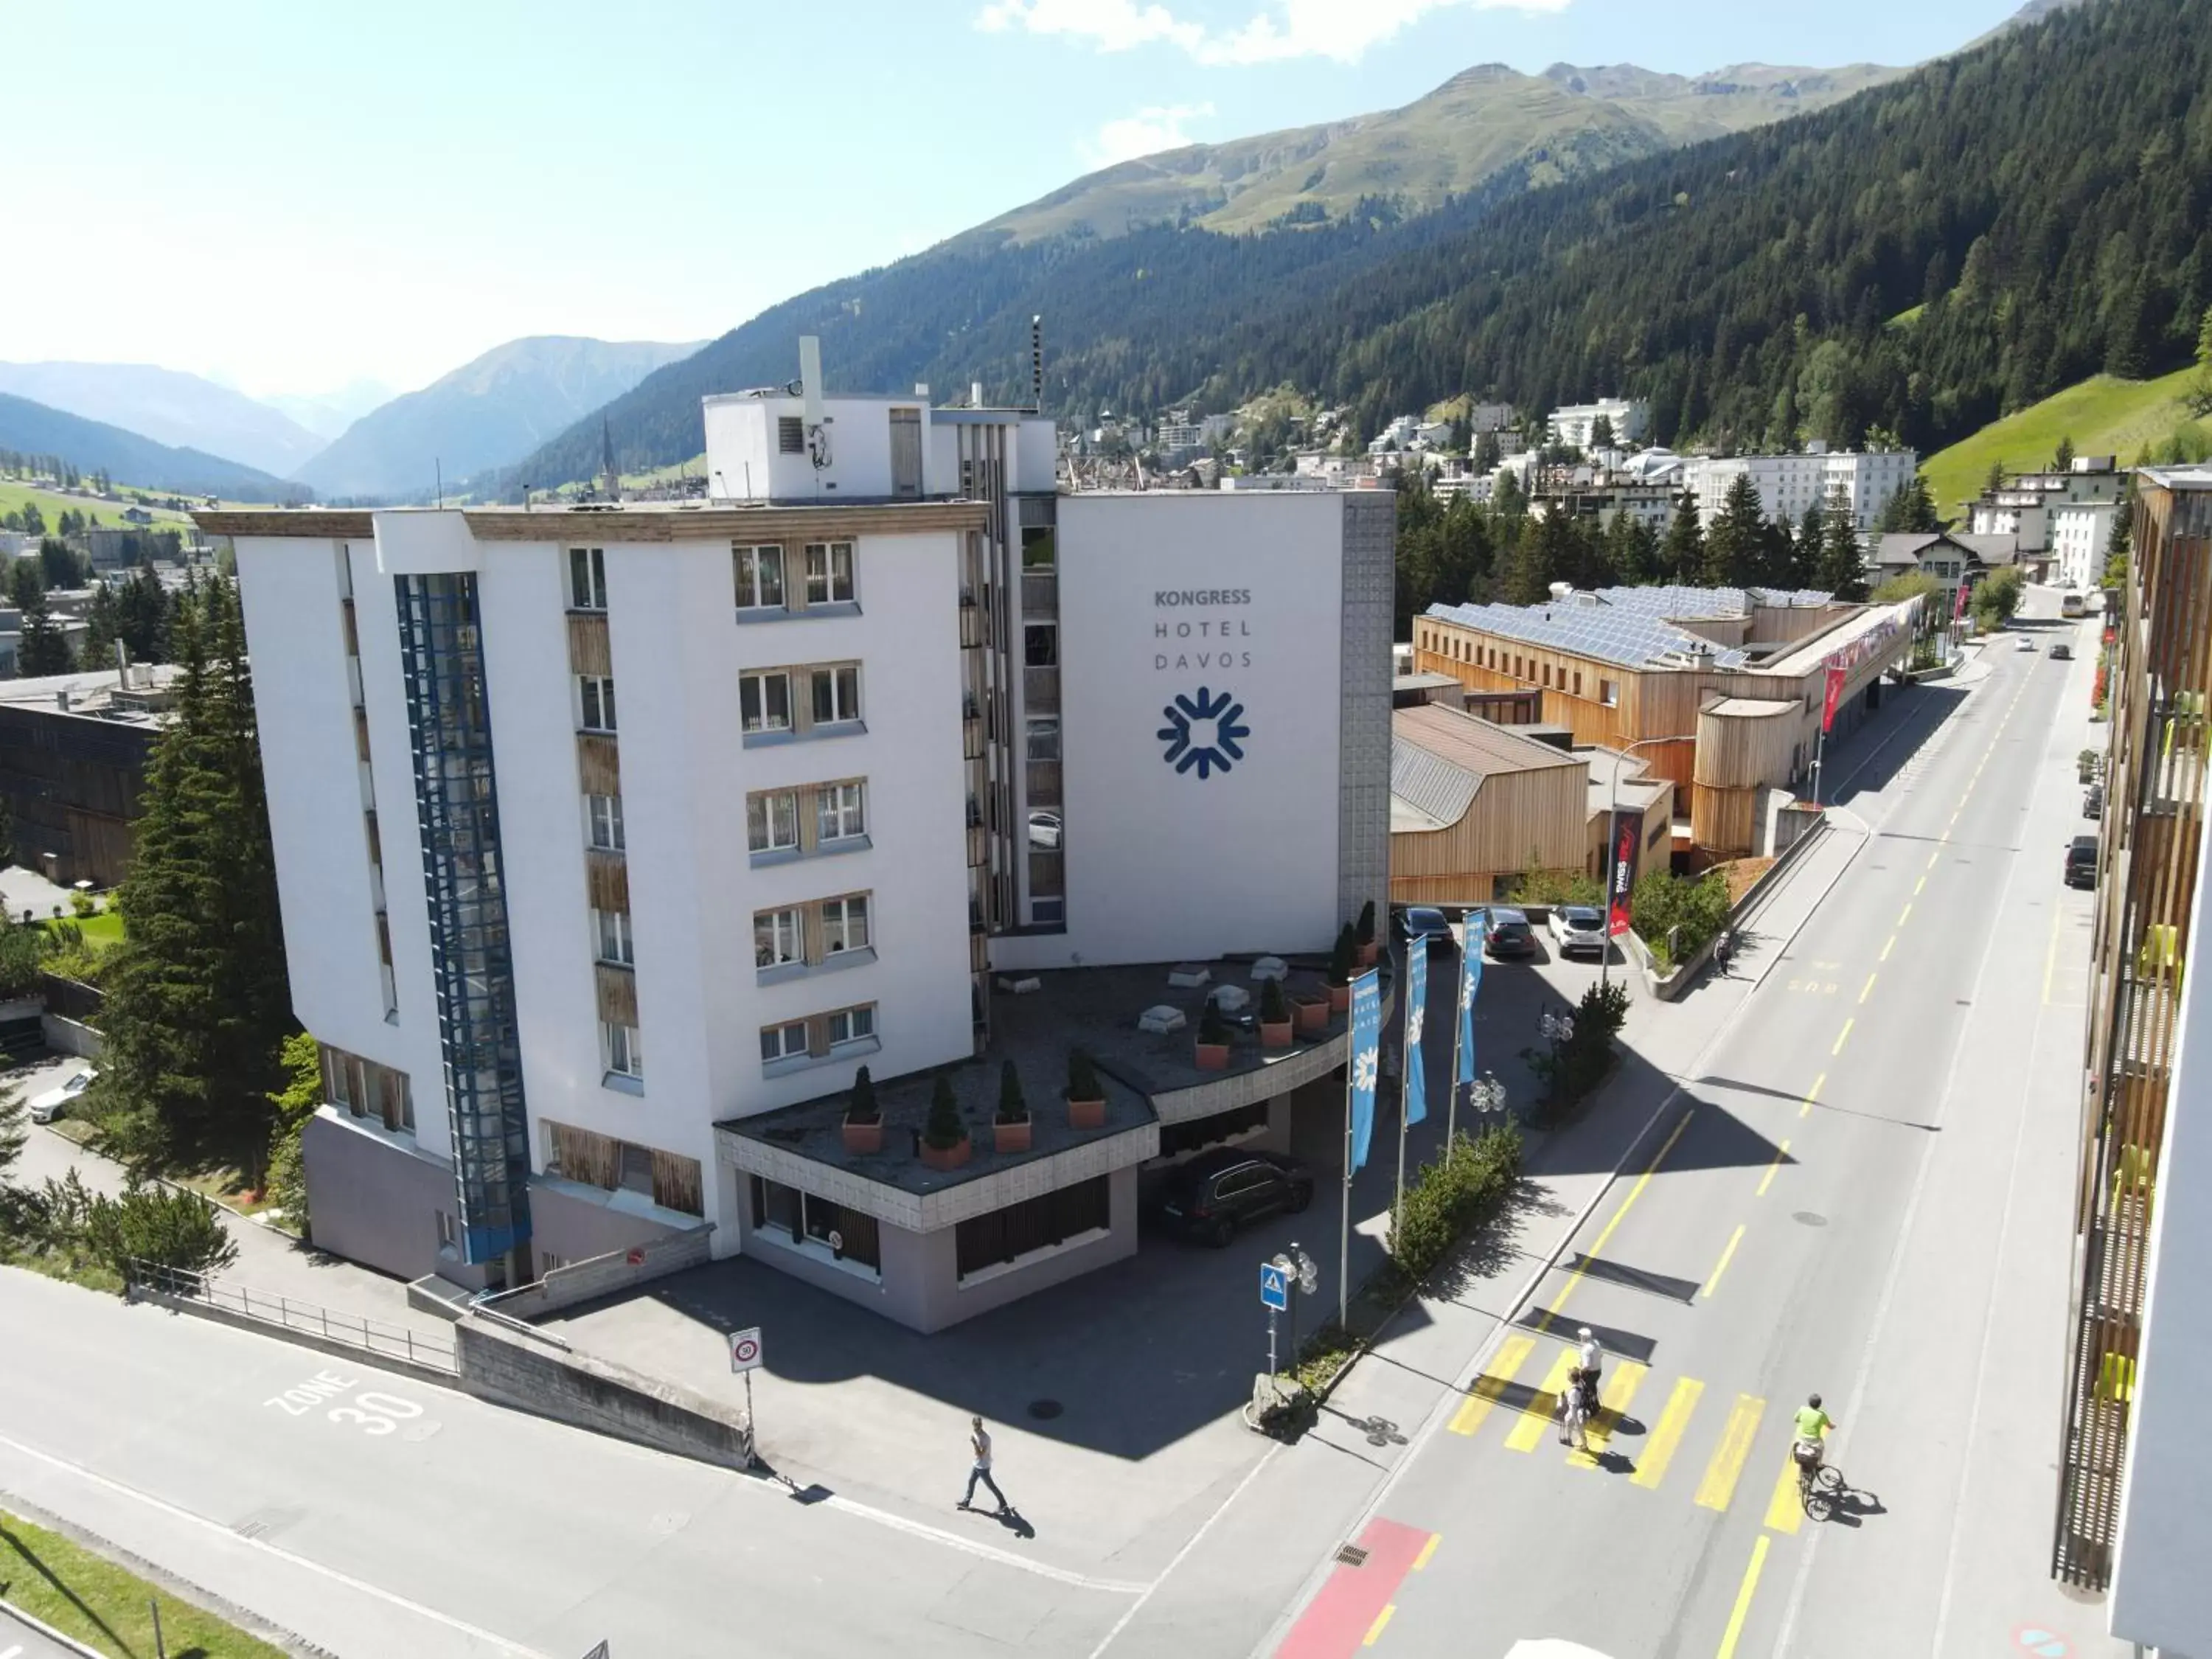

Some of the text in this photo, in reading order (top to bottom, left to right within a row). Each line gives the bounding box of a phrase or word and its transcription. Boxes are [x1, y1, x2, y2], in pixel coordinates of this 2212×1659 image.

[1155, 590, 1251, 606] KONGRESS
[1155, 620, 1251, 638] HOTEL
[1155, 652, 1251, 670] DAVOS
[262, 1369, 359, 1416] ZONE
[327, 1391, 424, 1435] 30
